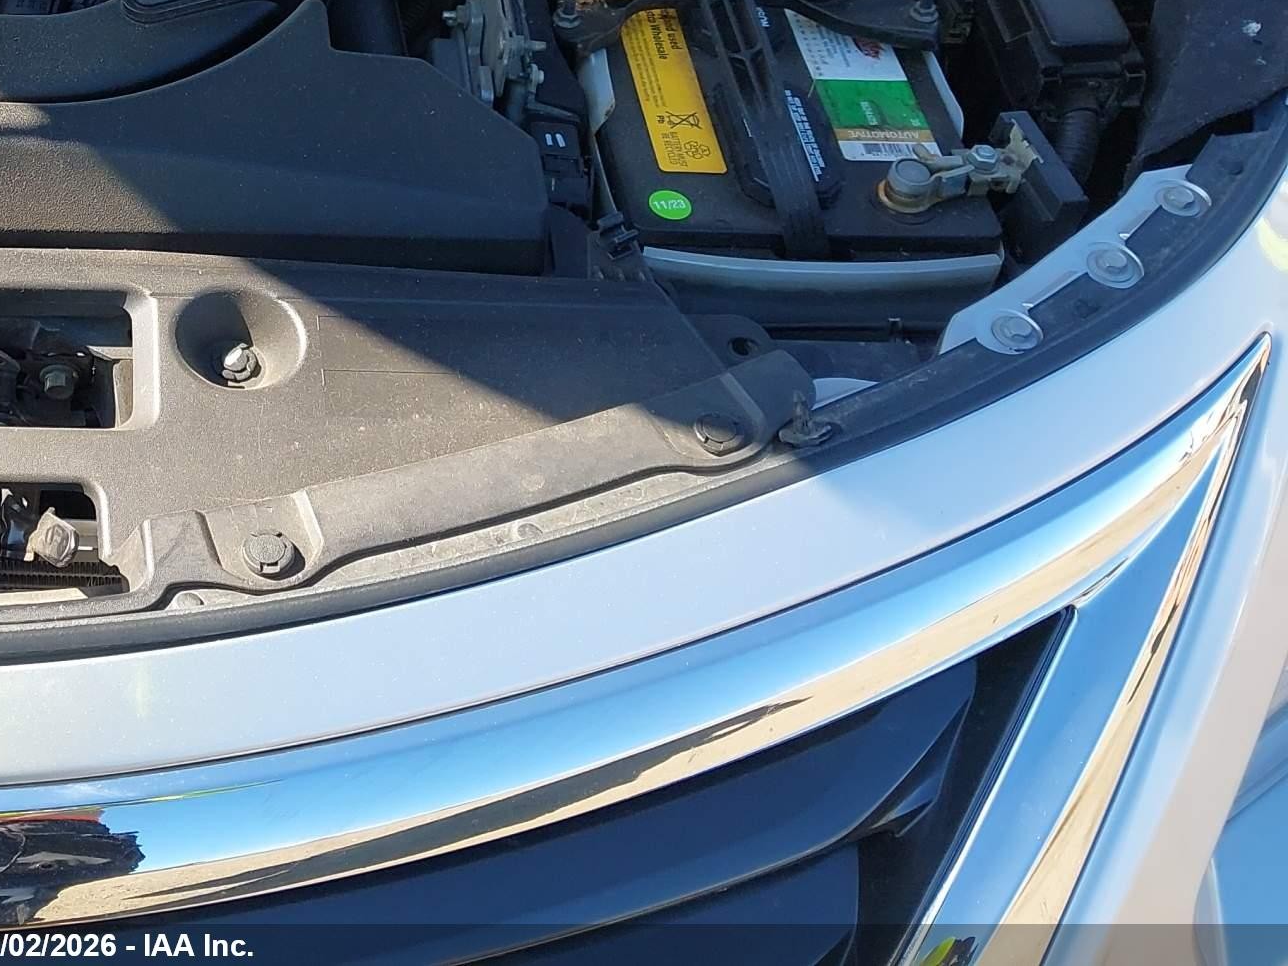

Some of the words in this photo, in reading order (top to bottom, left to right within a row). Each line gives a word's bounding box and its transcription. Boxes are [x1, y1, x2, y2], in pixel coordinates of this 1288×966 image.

[650, 25, 669, 60] Wholesale
[847, 130, 920, 140] AUTOMOTIVE
[653, 199, 686, 210] 11/23
